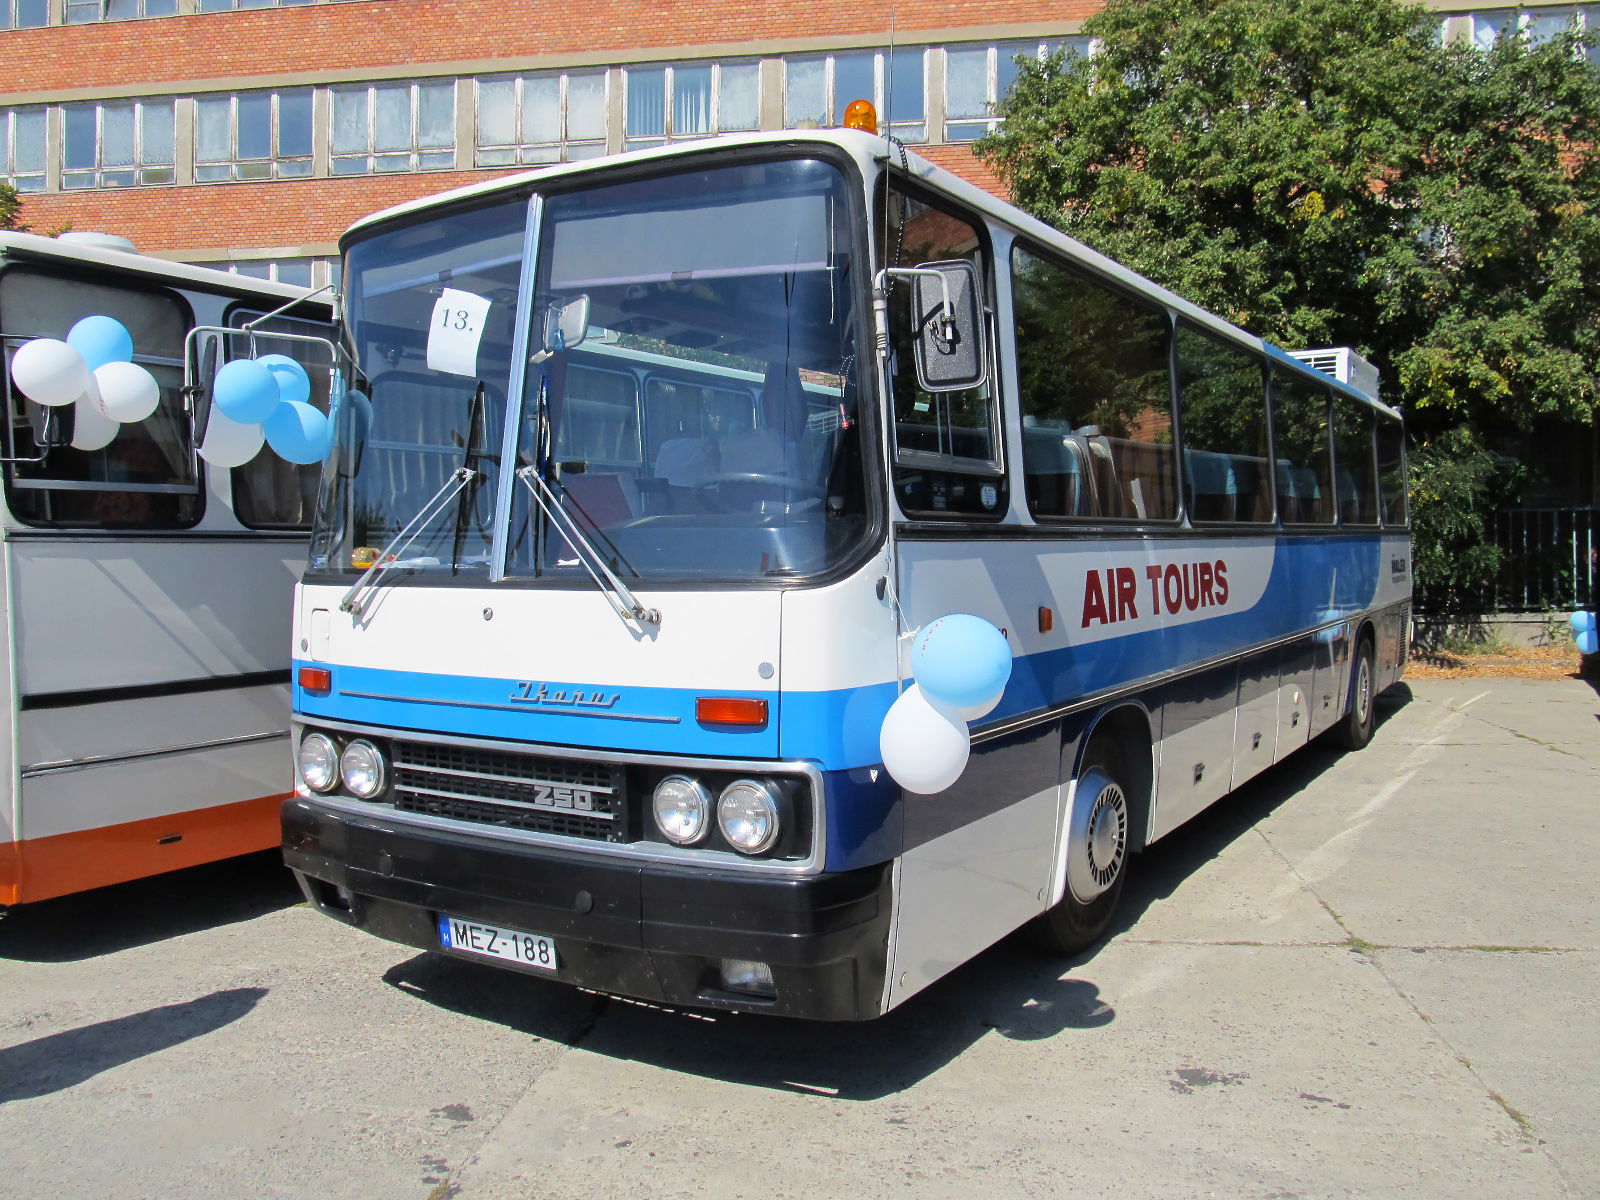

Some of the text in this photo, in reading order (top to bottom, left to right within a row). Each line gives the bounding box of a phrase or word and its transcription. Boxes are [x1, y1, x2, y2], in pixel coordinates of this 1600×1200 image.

[442, 308, 473, 332] 13.
[1081, 559, 1229, 628] AIR TOURS
[509, 681, 620, 709] Ikarus
[533, 785, 593, 811] 250
[443, 932, 450, 943] H
[453, 922, 550, 965] MEZ-188
